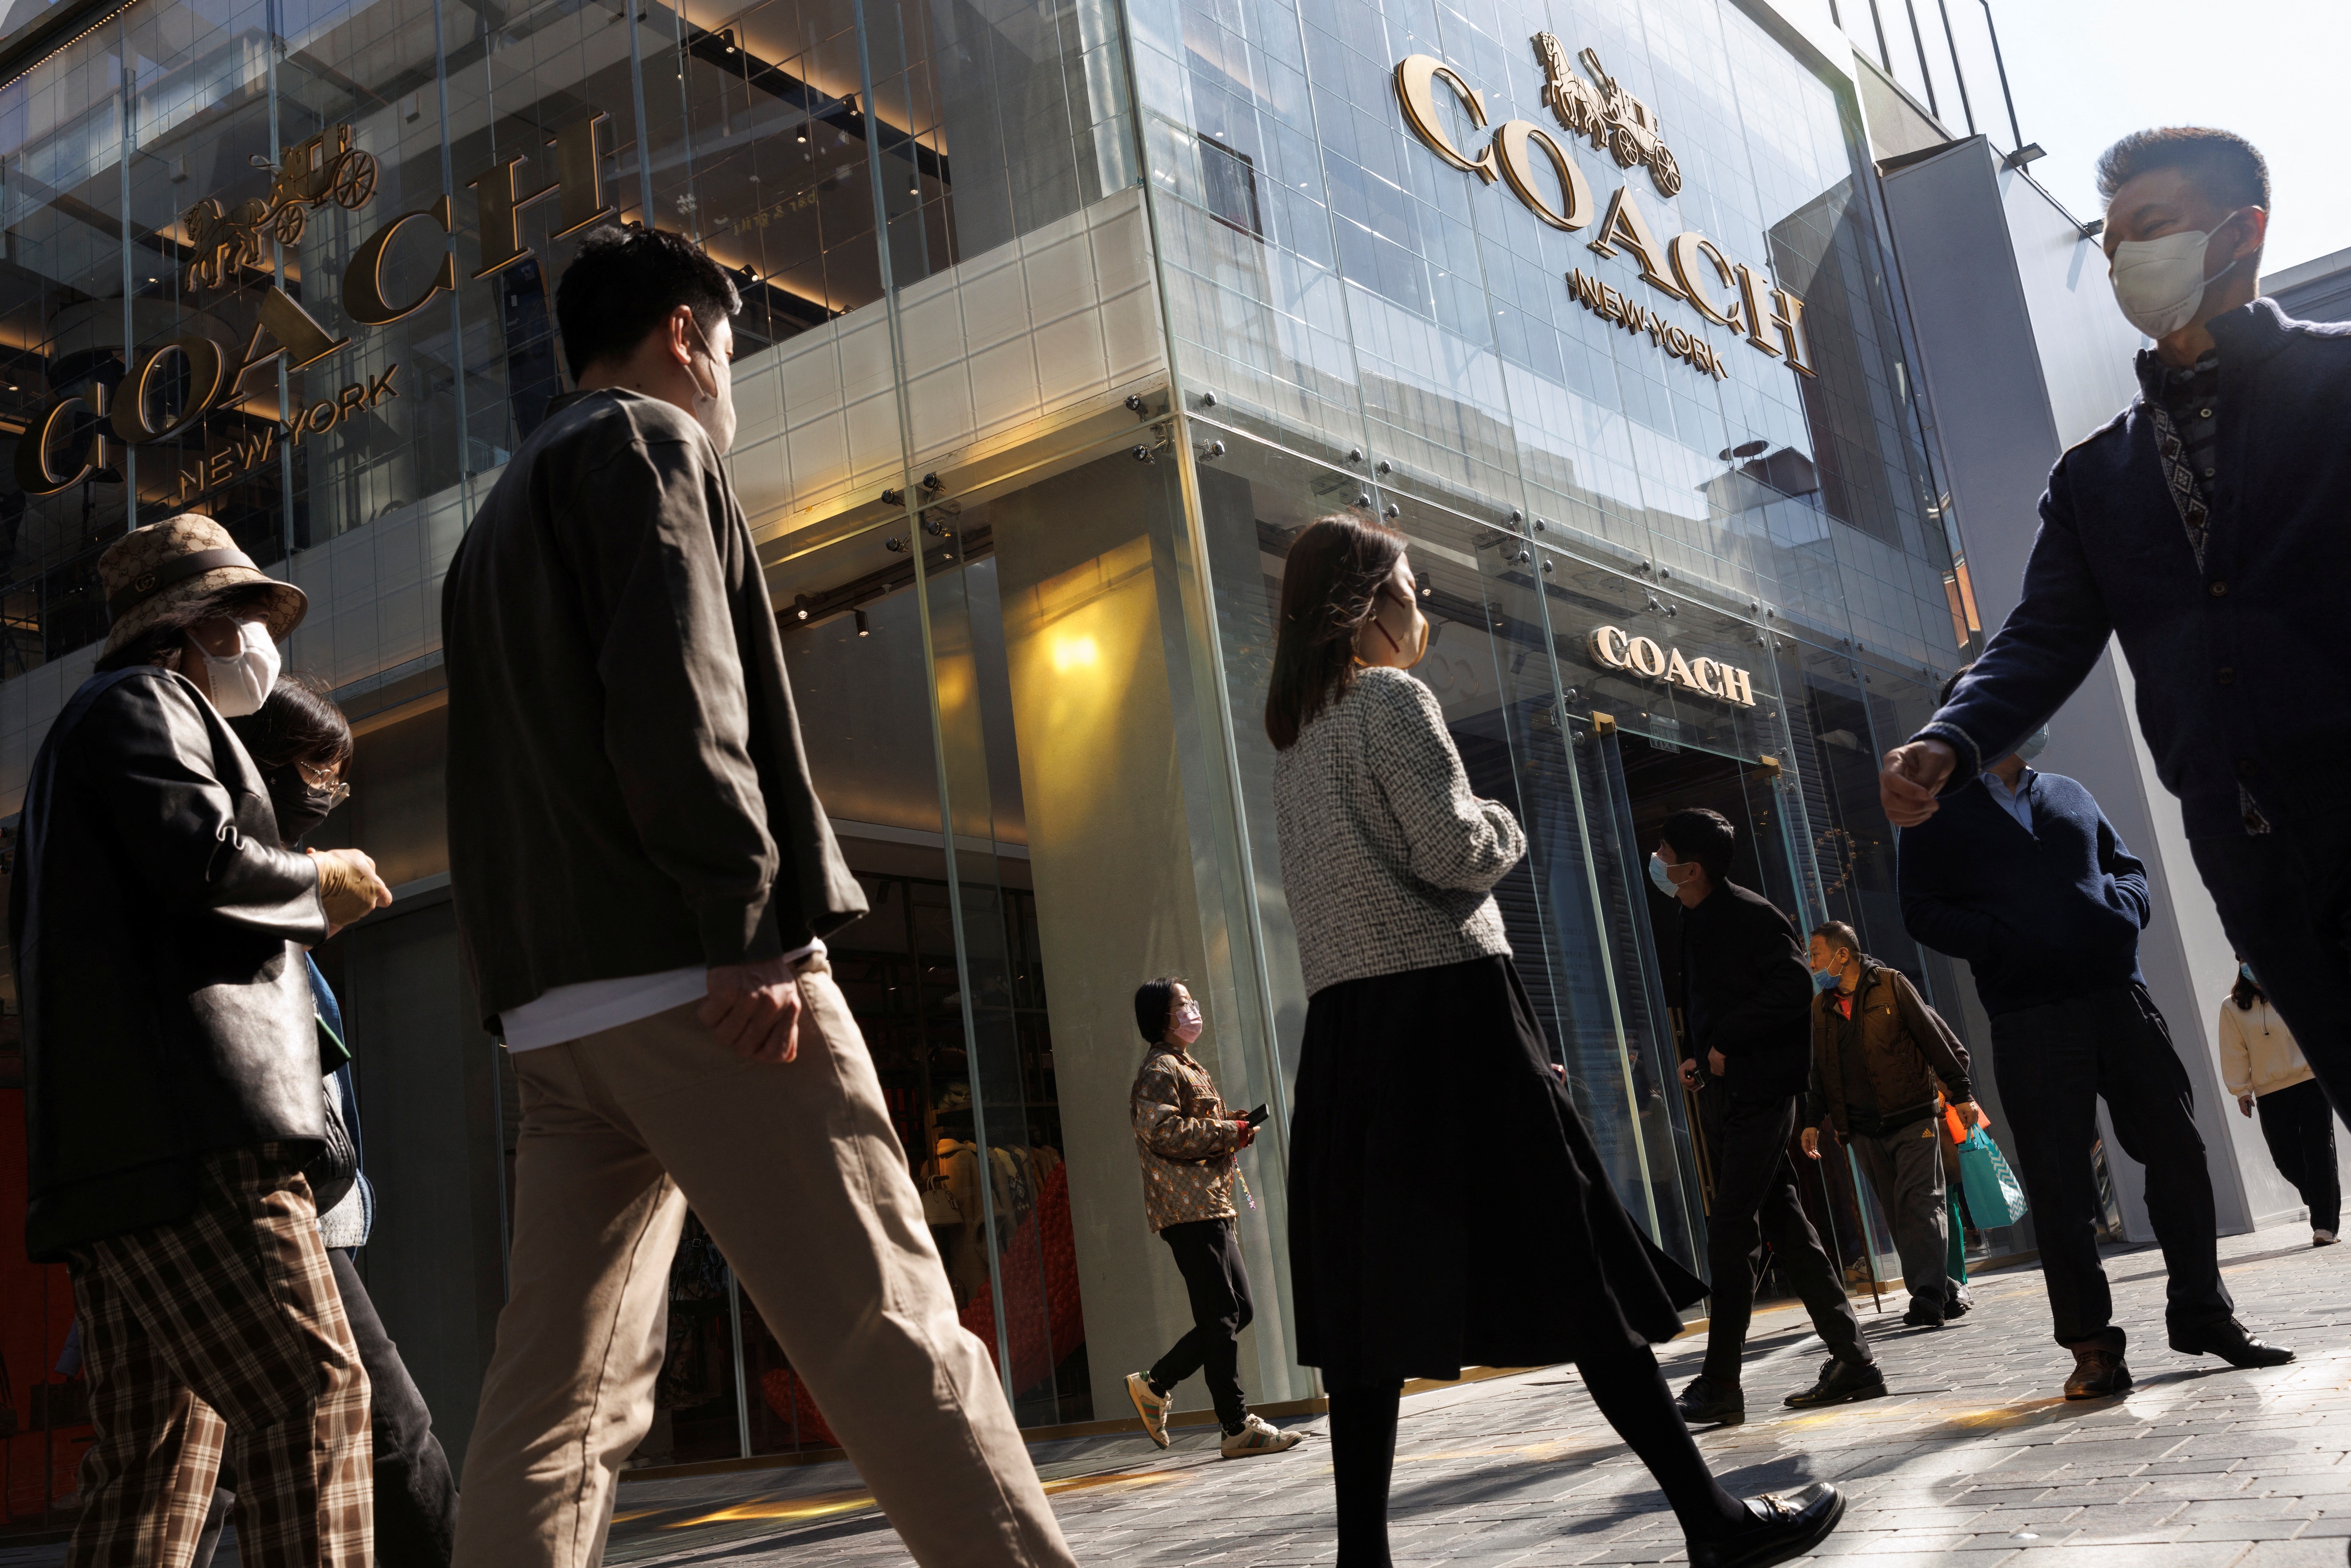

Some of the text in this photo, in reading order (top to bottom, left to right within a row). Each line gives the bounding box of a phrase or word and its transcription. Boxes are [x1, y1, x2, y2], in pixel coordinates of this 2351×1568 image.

[1392, 54, 1818, 380] COACH
[14, 111, 618, 496] COACH
[1565, 267, 1728, 381] NEW YORK
[177, 362, 399, 501] NEW YORK
[1593, 625, 1757, 707] COACH
